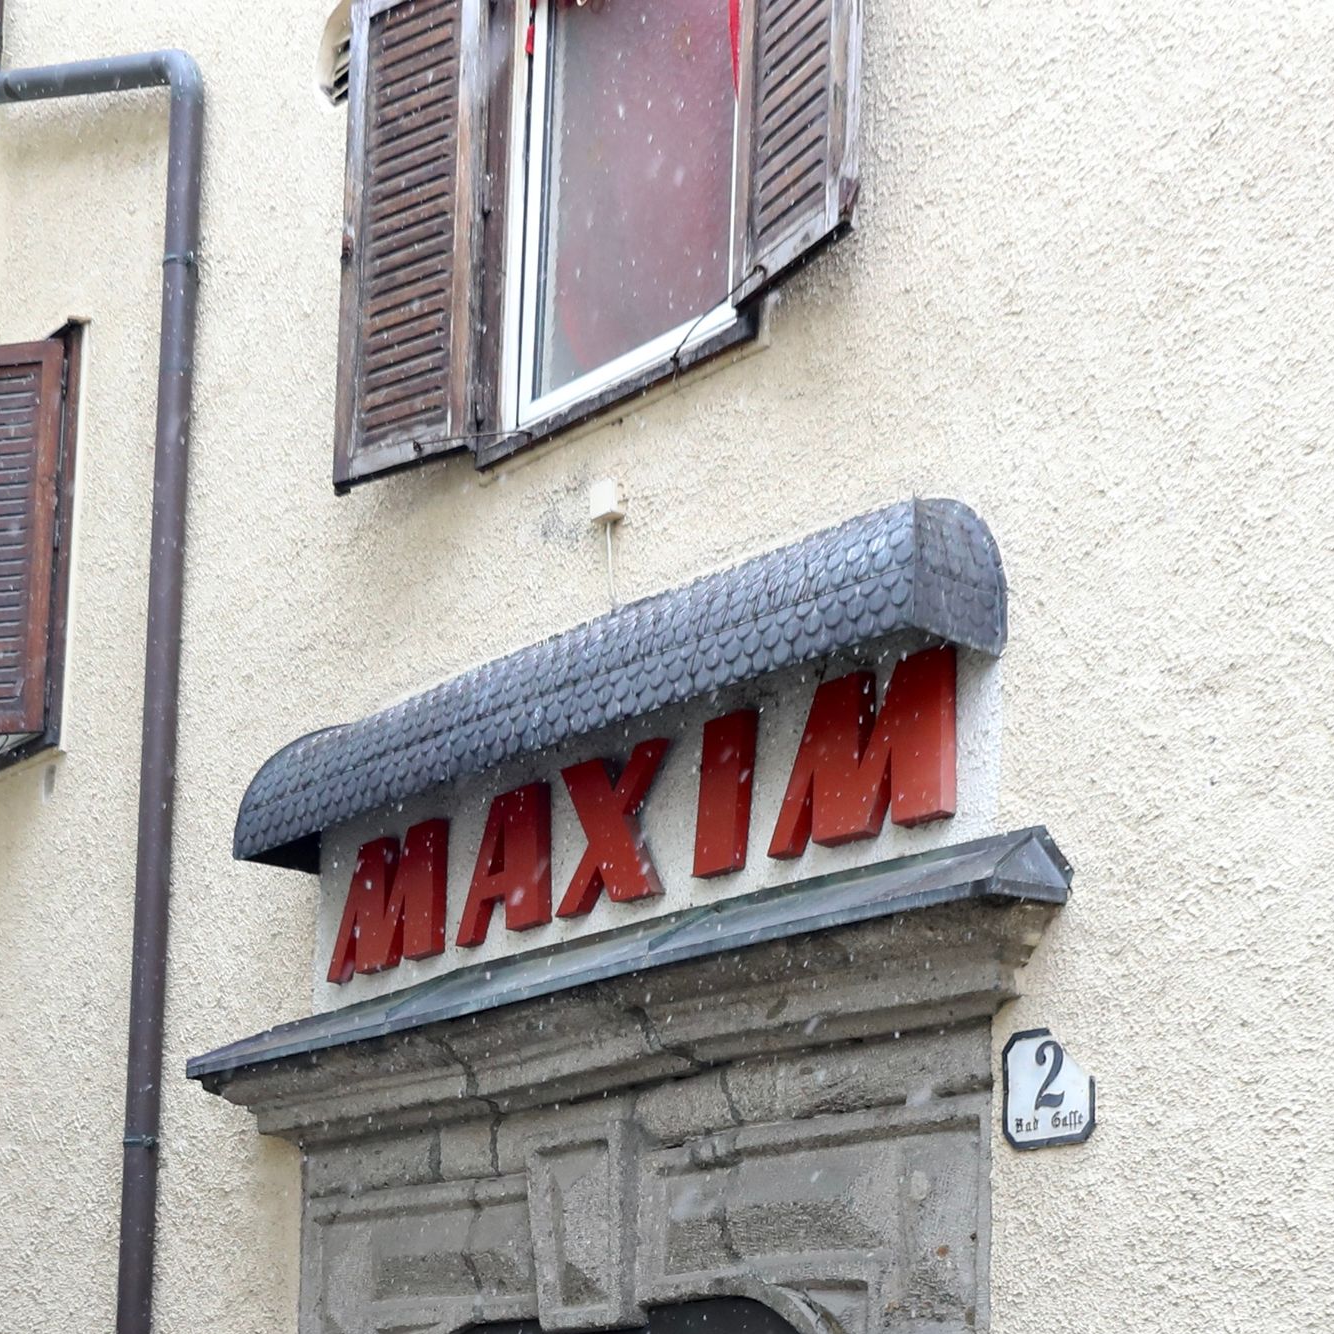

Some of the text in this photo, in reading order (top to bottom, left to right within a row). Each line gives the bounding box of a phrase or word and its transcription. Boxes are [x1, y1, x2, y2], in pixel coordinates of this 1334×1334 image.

[326, 646, 957, 984] MAXIM
[1034, 1040, 1065, 1110] 2
[1014, 1115, 1039, 1133] Bad
